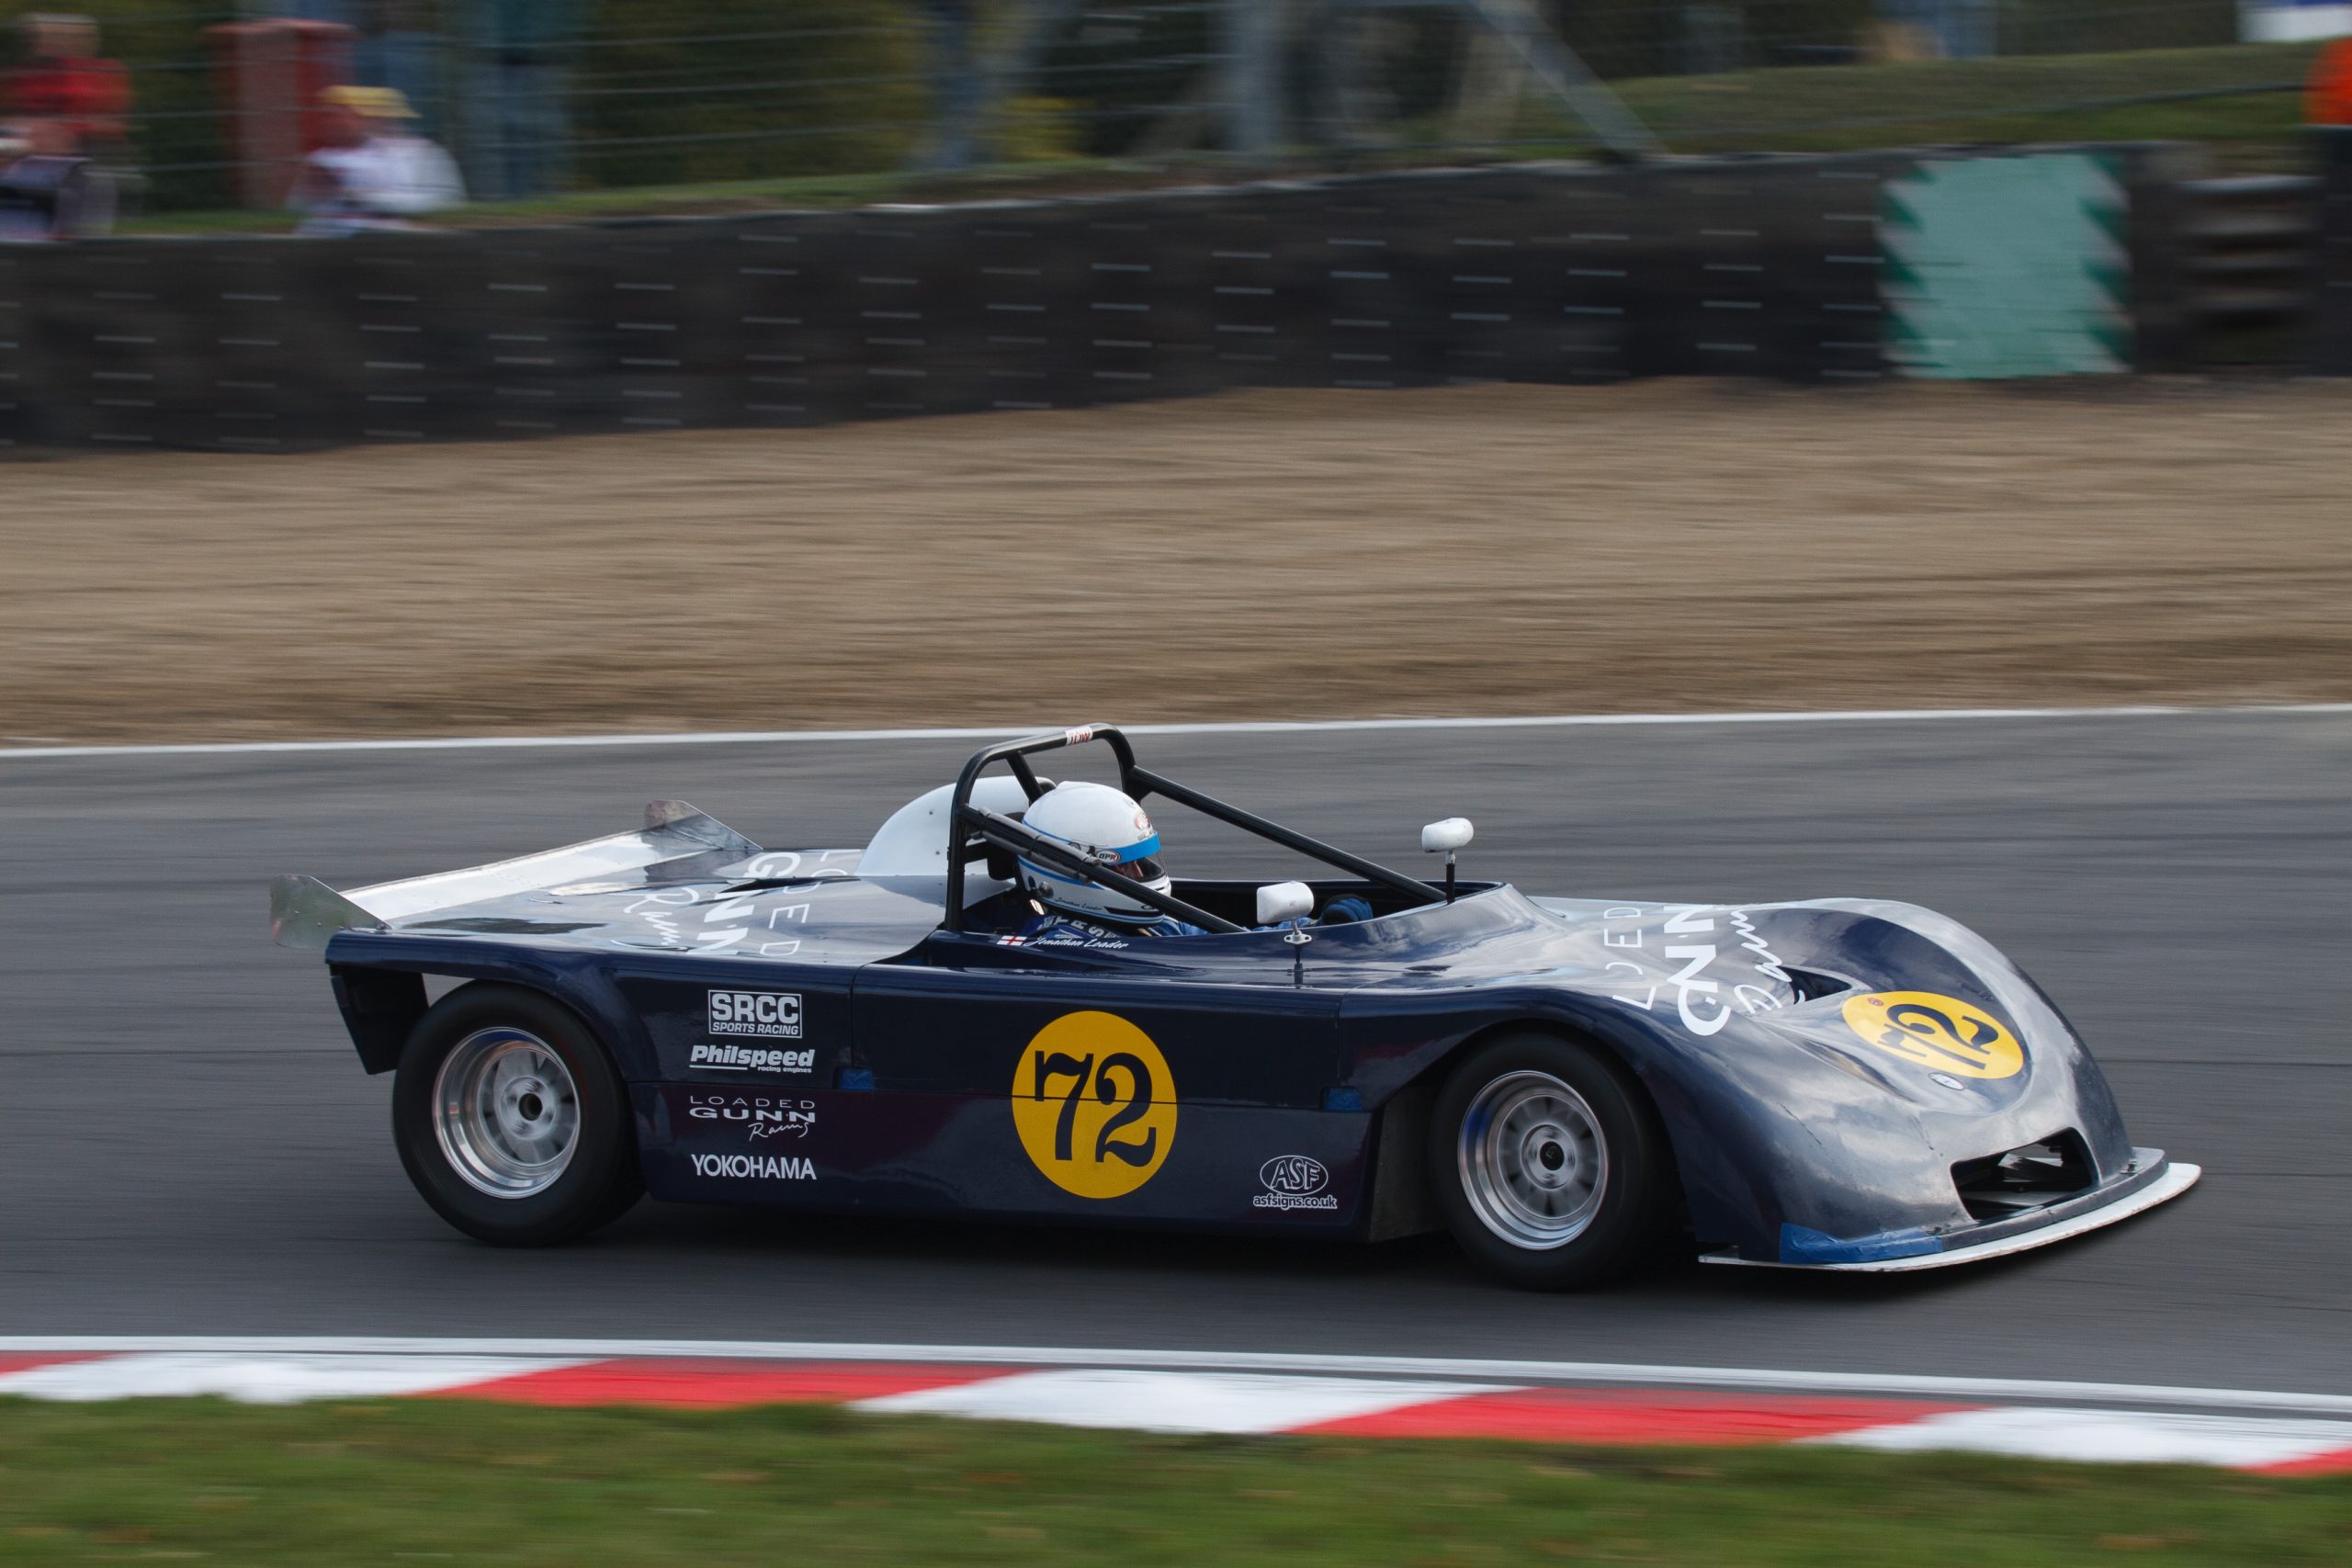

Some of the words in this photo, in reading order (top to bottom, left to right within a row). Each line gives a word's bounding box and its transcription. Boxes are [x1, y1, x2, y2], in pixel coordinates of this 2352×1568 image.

[1023, 936, 1084, 947] Jonathan
[711, 993, 799, 1024] SRCC
[712, 1021, 756, 1033] SPORTS
[756, 1023, 799, 1036] RACING
[1877, 1003, 1999, 1070] 72
[690, 1044, 816, 1067] Philspeed
[757, 1066, 782, 1074] racing
[783, 1066, 812, 1075] engines
[690, 1095, 815, 1110] LOADED
[1034, 1050, 1157, 1168] 72
[747, 1122, 809, 1142] Racing
[691, 1154, 817, 1180] YOKOHAMA
[1270, 1157, 1321, 1190] ASF
[1252, 1193, 1339, 1211] asfsigns.co.uk
